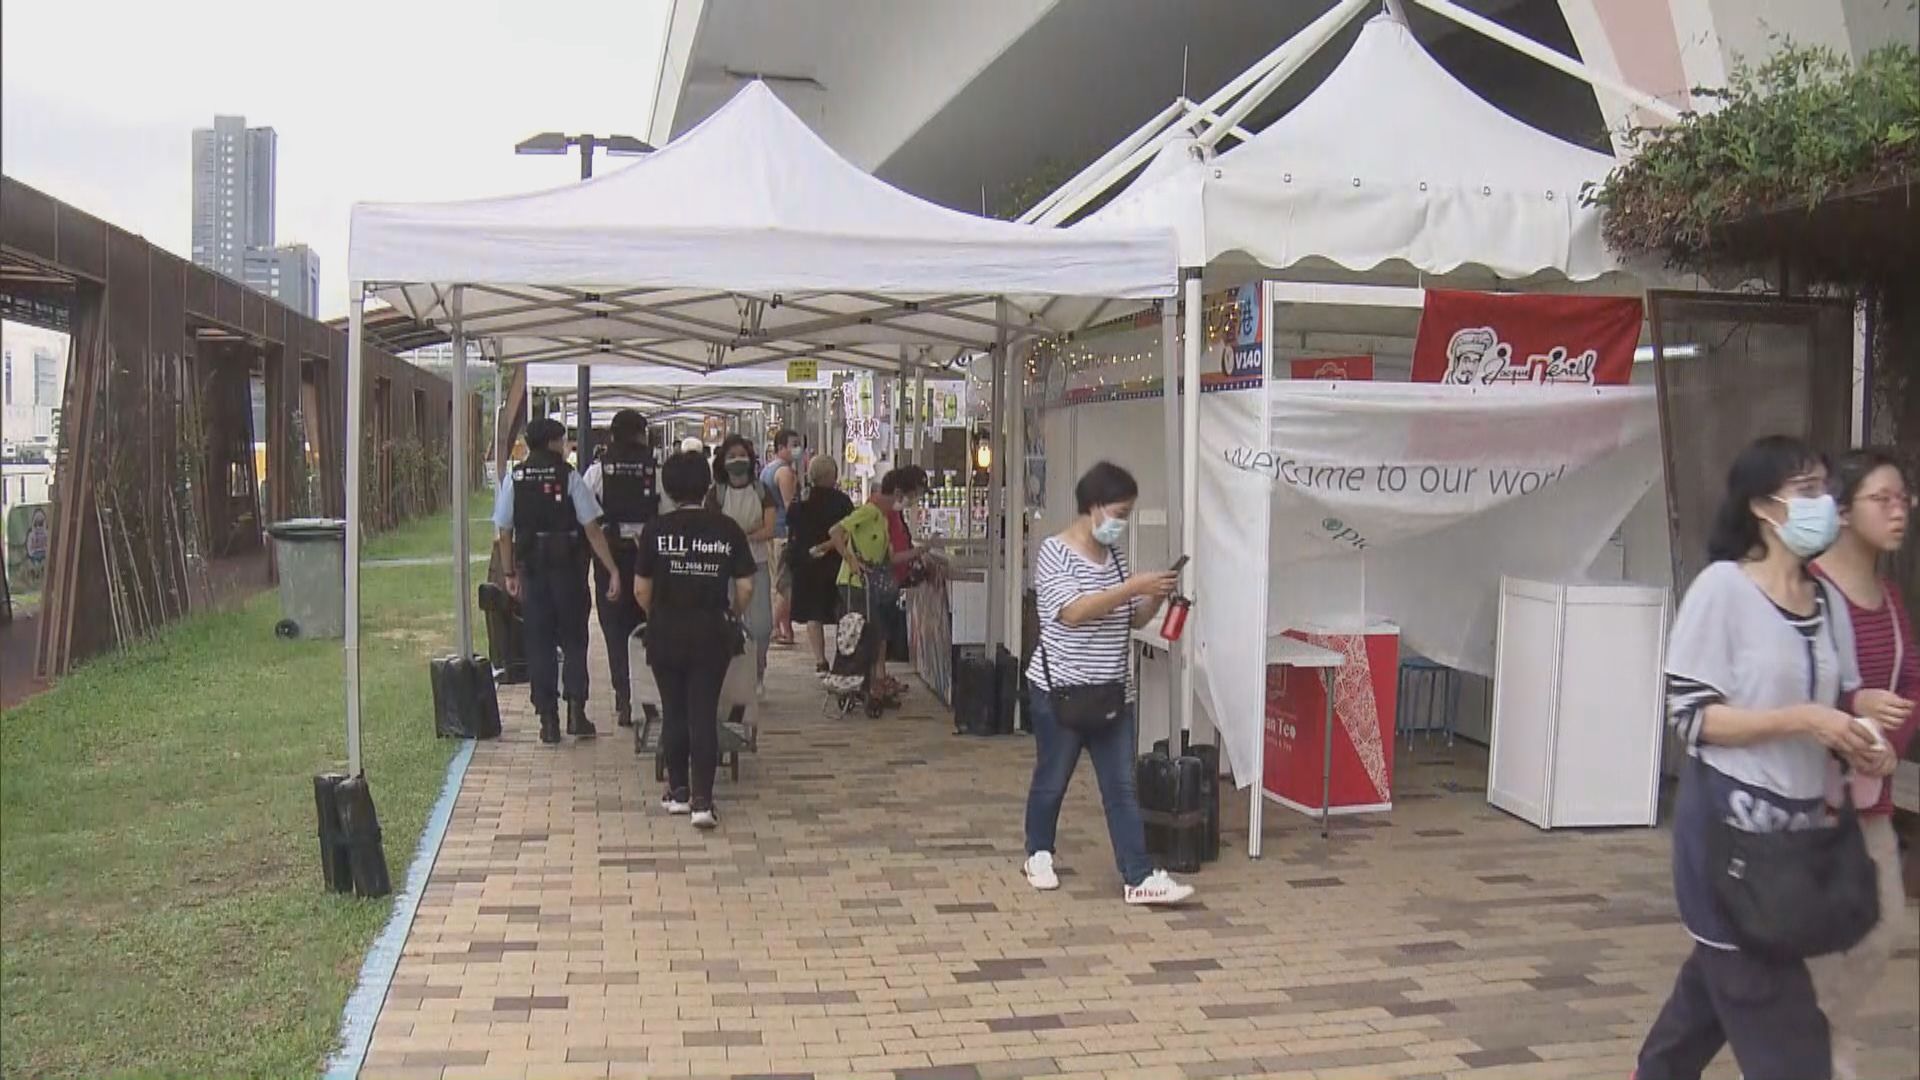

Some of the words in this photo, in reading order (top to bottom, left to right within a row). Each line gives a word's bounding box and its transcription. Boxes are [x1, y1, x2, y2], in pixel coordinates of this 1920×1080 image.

[1235, 347, 1262, 371] V140
[1376, 463, 1408, 493] to
[1419, 464, 1479, 494] our
